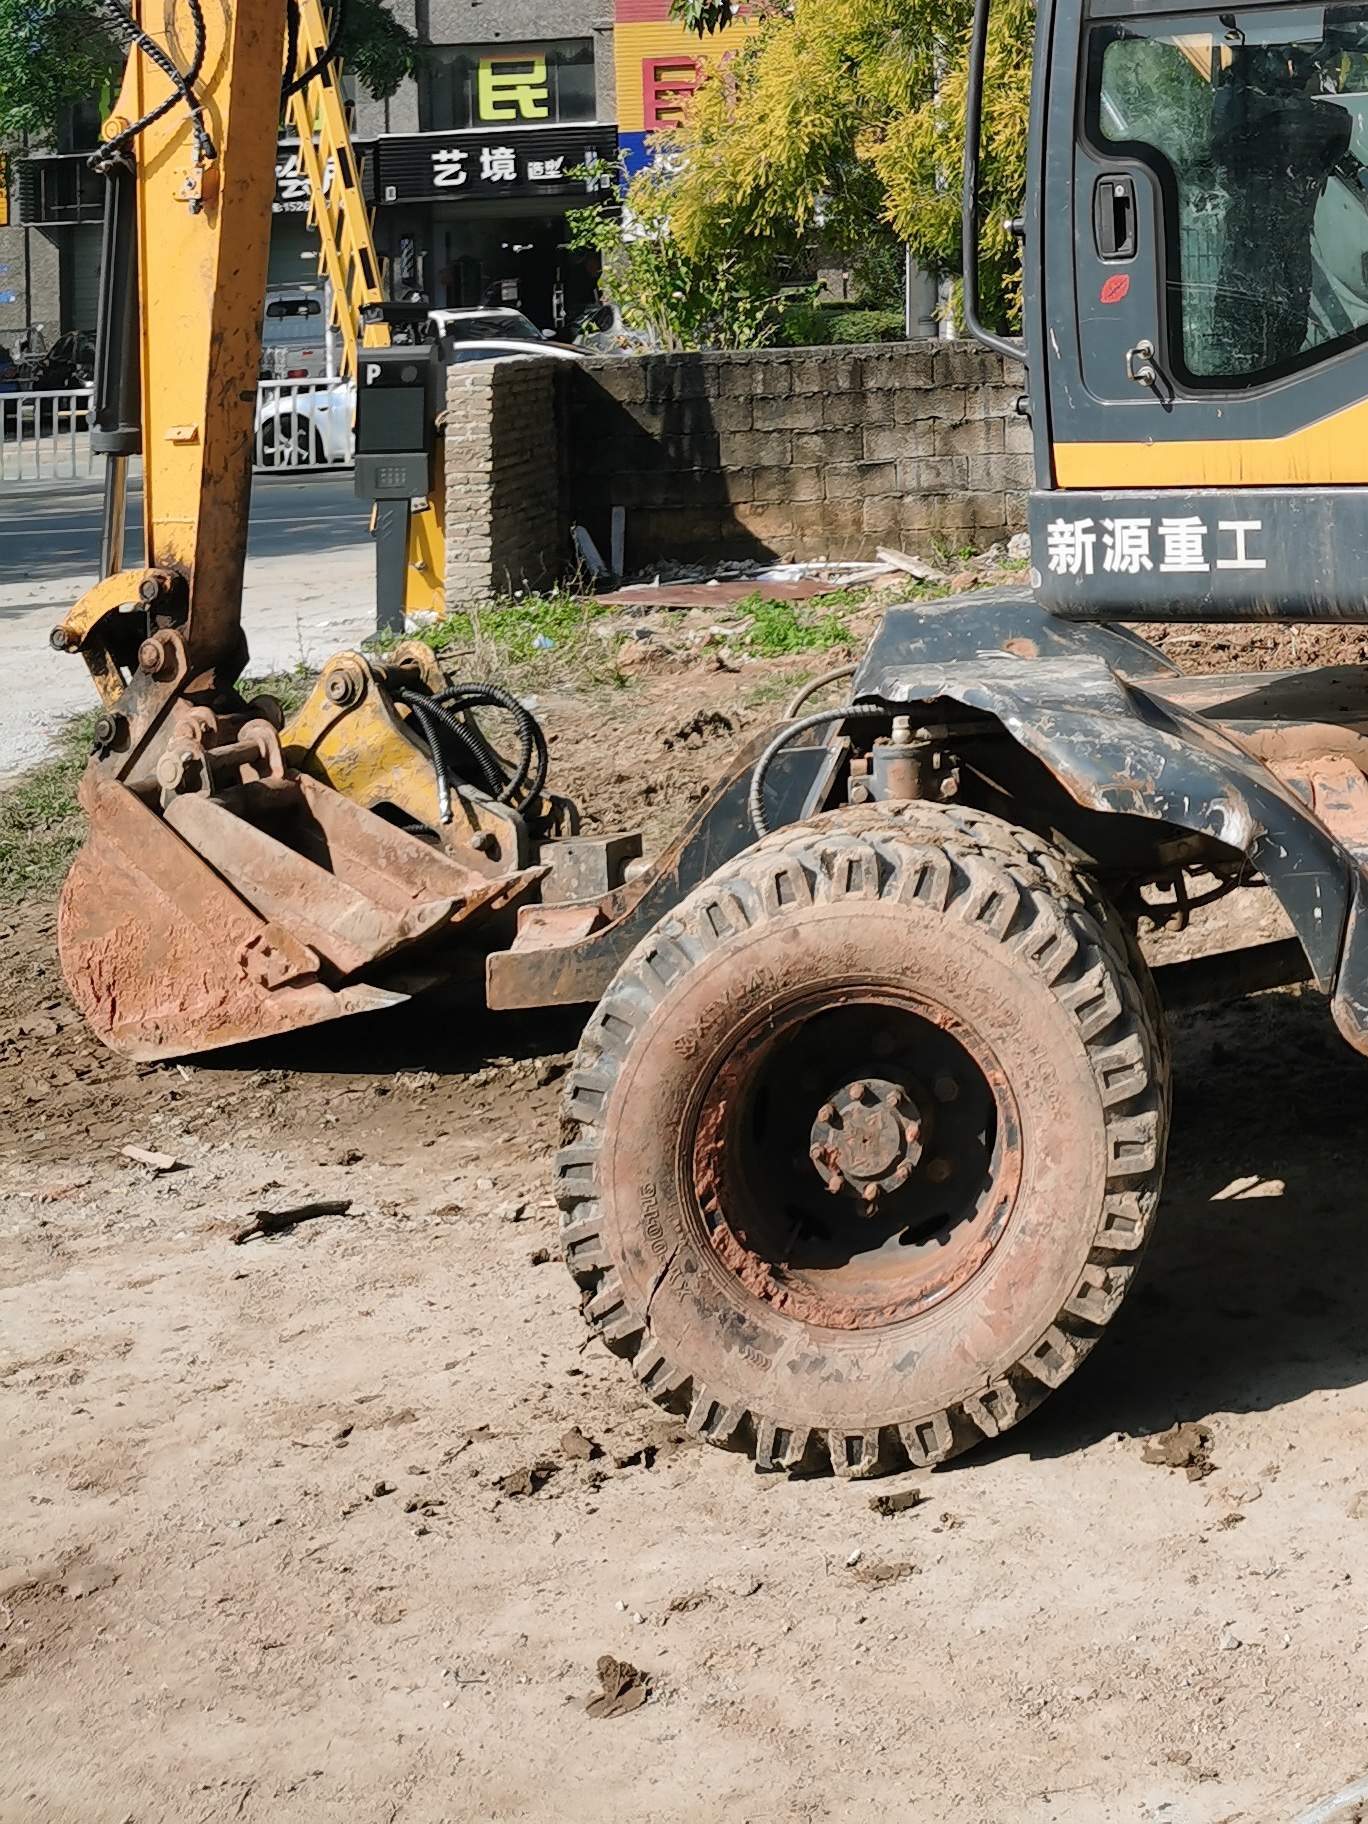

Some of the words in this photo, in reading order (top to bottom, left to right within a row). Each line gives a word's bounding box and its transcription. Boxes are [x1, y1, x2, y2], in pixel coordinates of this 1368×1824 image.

[478, 53, 549, 121] 民
[366, 363, 382, 386] P
[1047, 516, 1266, 575] 新源重工
